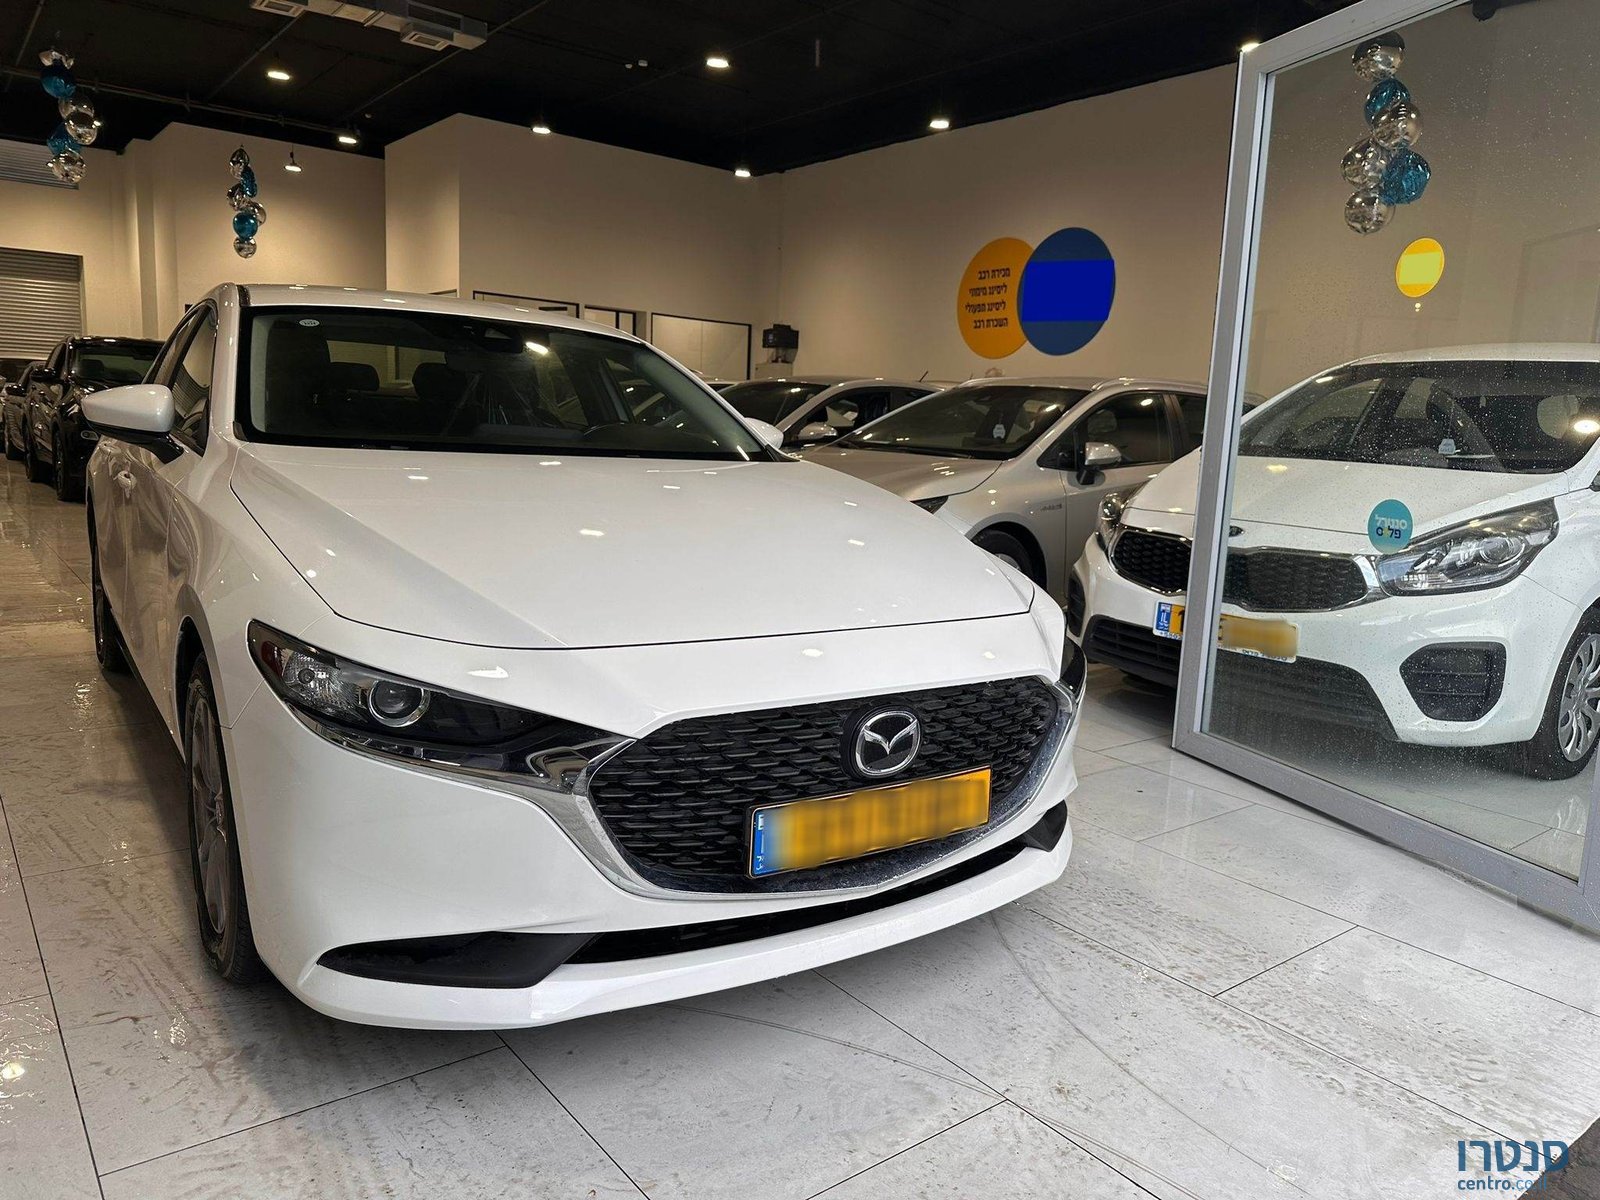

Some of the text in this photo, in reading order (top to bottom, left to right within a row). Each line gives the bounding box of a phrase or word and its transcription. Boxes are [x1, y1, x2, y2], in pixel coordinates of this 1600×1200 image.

[978, 267, 1010, 280] מכירת רכב
[988, 283, 1007, 295] ליסינג
[987, 300, 1006, 312] ליסינג
[973, 317, 1008, 329] השכרת רכב
[1375, 514, 1408, 530] סנטרל
